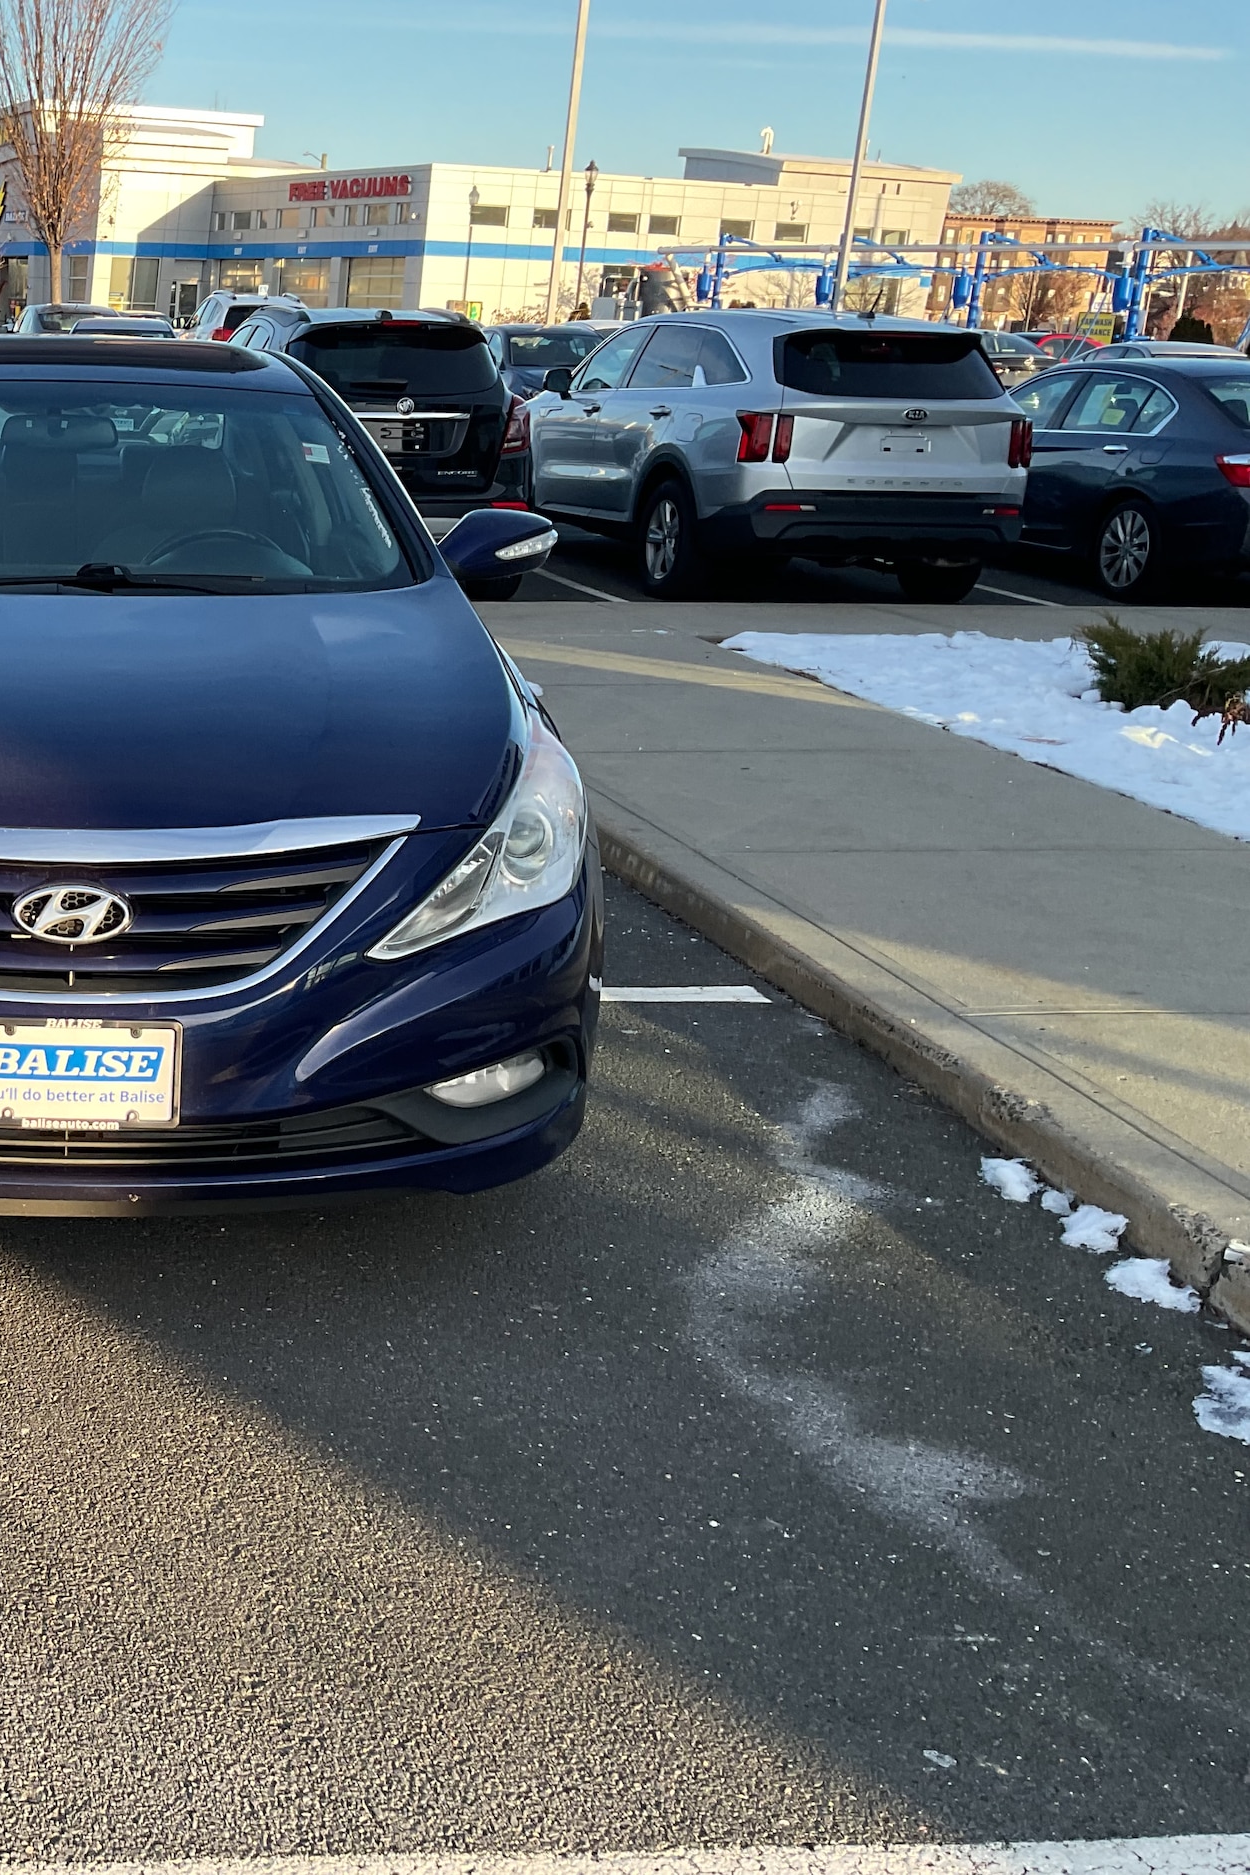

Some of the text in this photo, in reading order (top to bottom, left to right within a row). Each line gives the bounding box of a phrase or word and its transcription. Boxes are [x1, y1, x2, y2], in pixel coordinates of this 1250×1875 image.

[289, 175, 412, 201] FREE VACUUMS
[46, 1018, 103, 1029] BALISE
[22, 1087, 42, 1101] do
[46, 1088, 95, 1102] better
[99, 1091, 115, 1103] at
[120, 1089, 165, 1103] Balise
[21, 1117, 120, 1130] baliseauto.com
